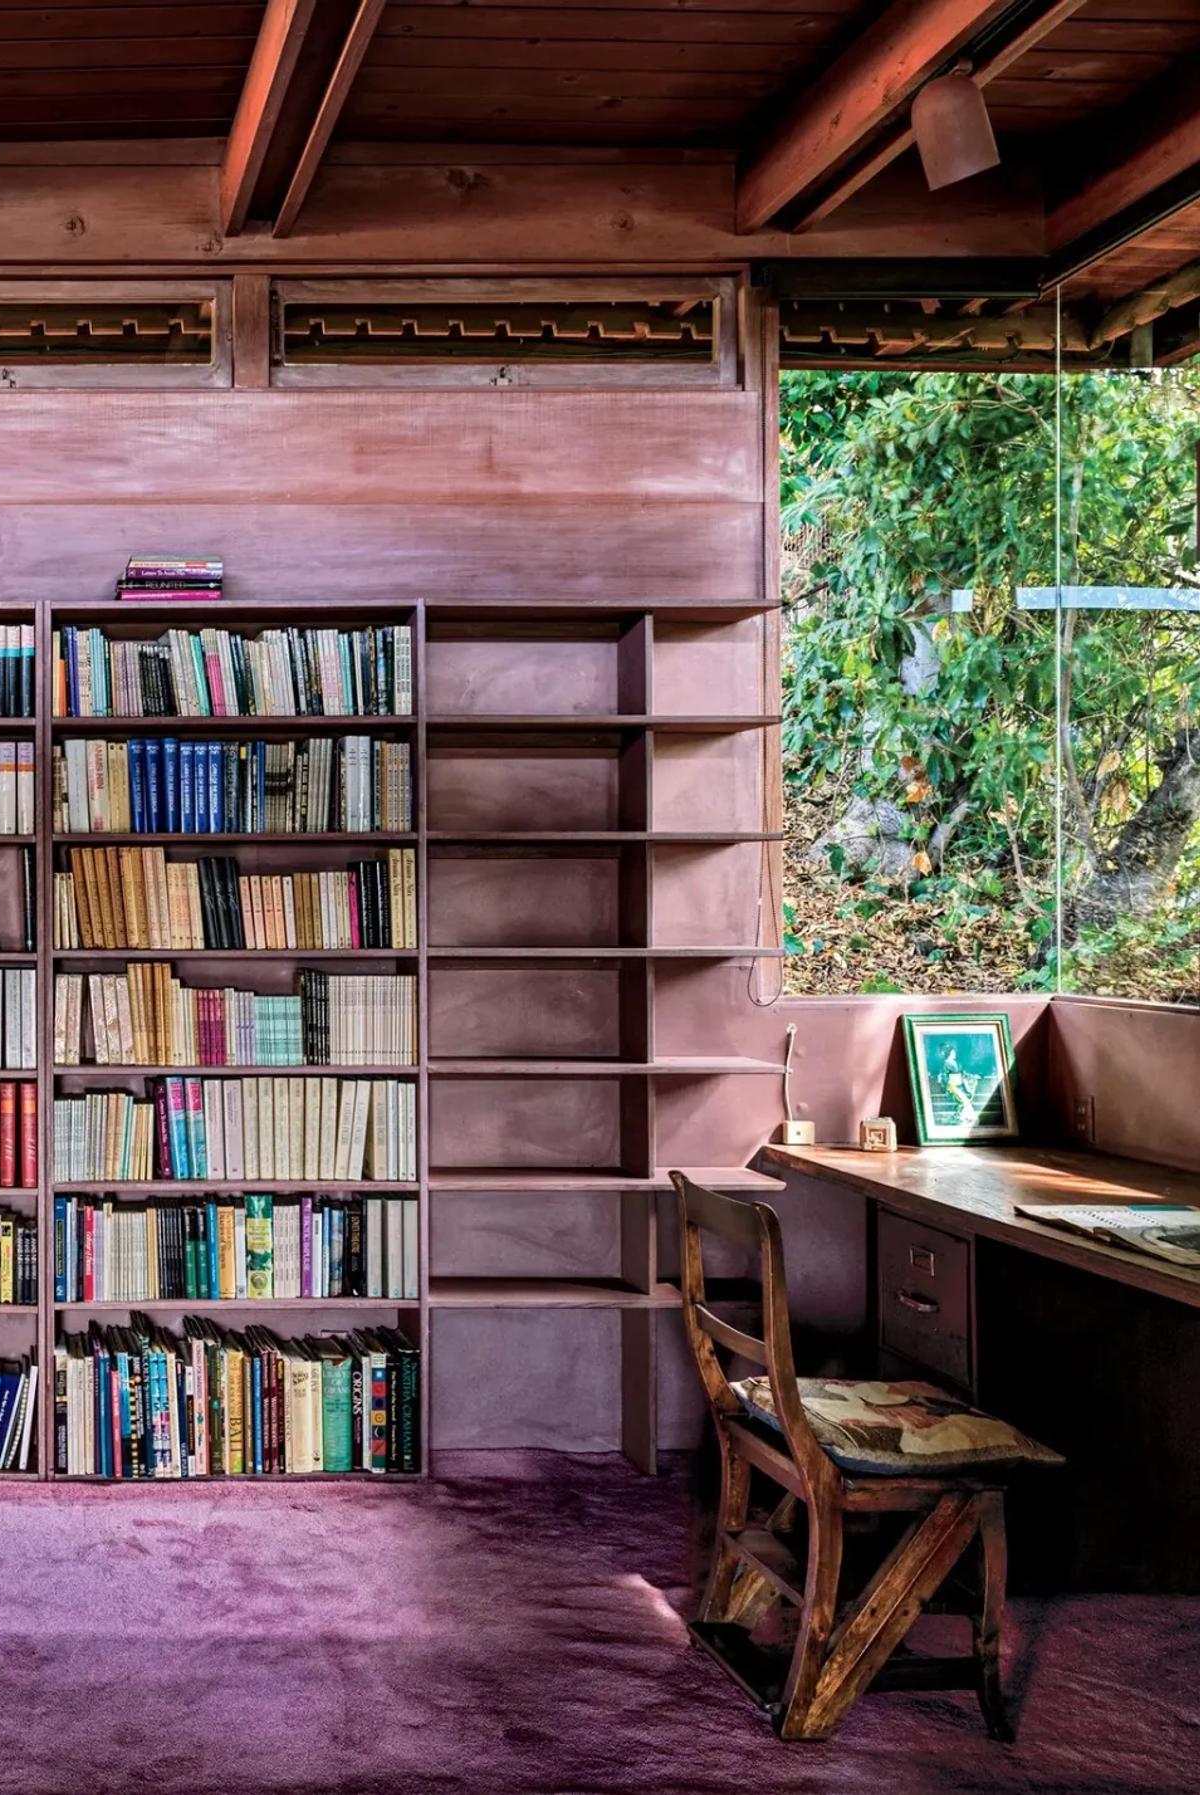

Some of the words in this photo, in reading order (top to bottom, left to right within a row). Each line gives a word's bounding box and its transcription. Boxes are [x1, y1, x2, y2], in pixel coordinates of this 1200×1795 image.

[353, 1371, 362, 1415] ORIGINS
[402, 1357, 411, 1402] MARTHA
[230, 1417, 242, 1453] BALI
[402, 1404, 411, 1453] GRAHAM
